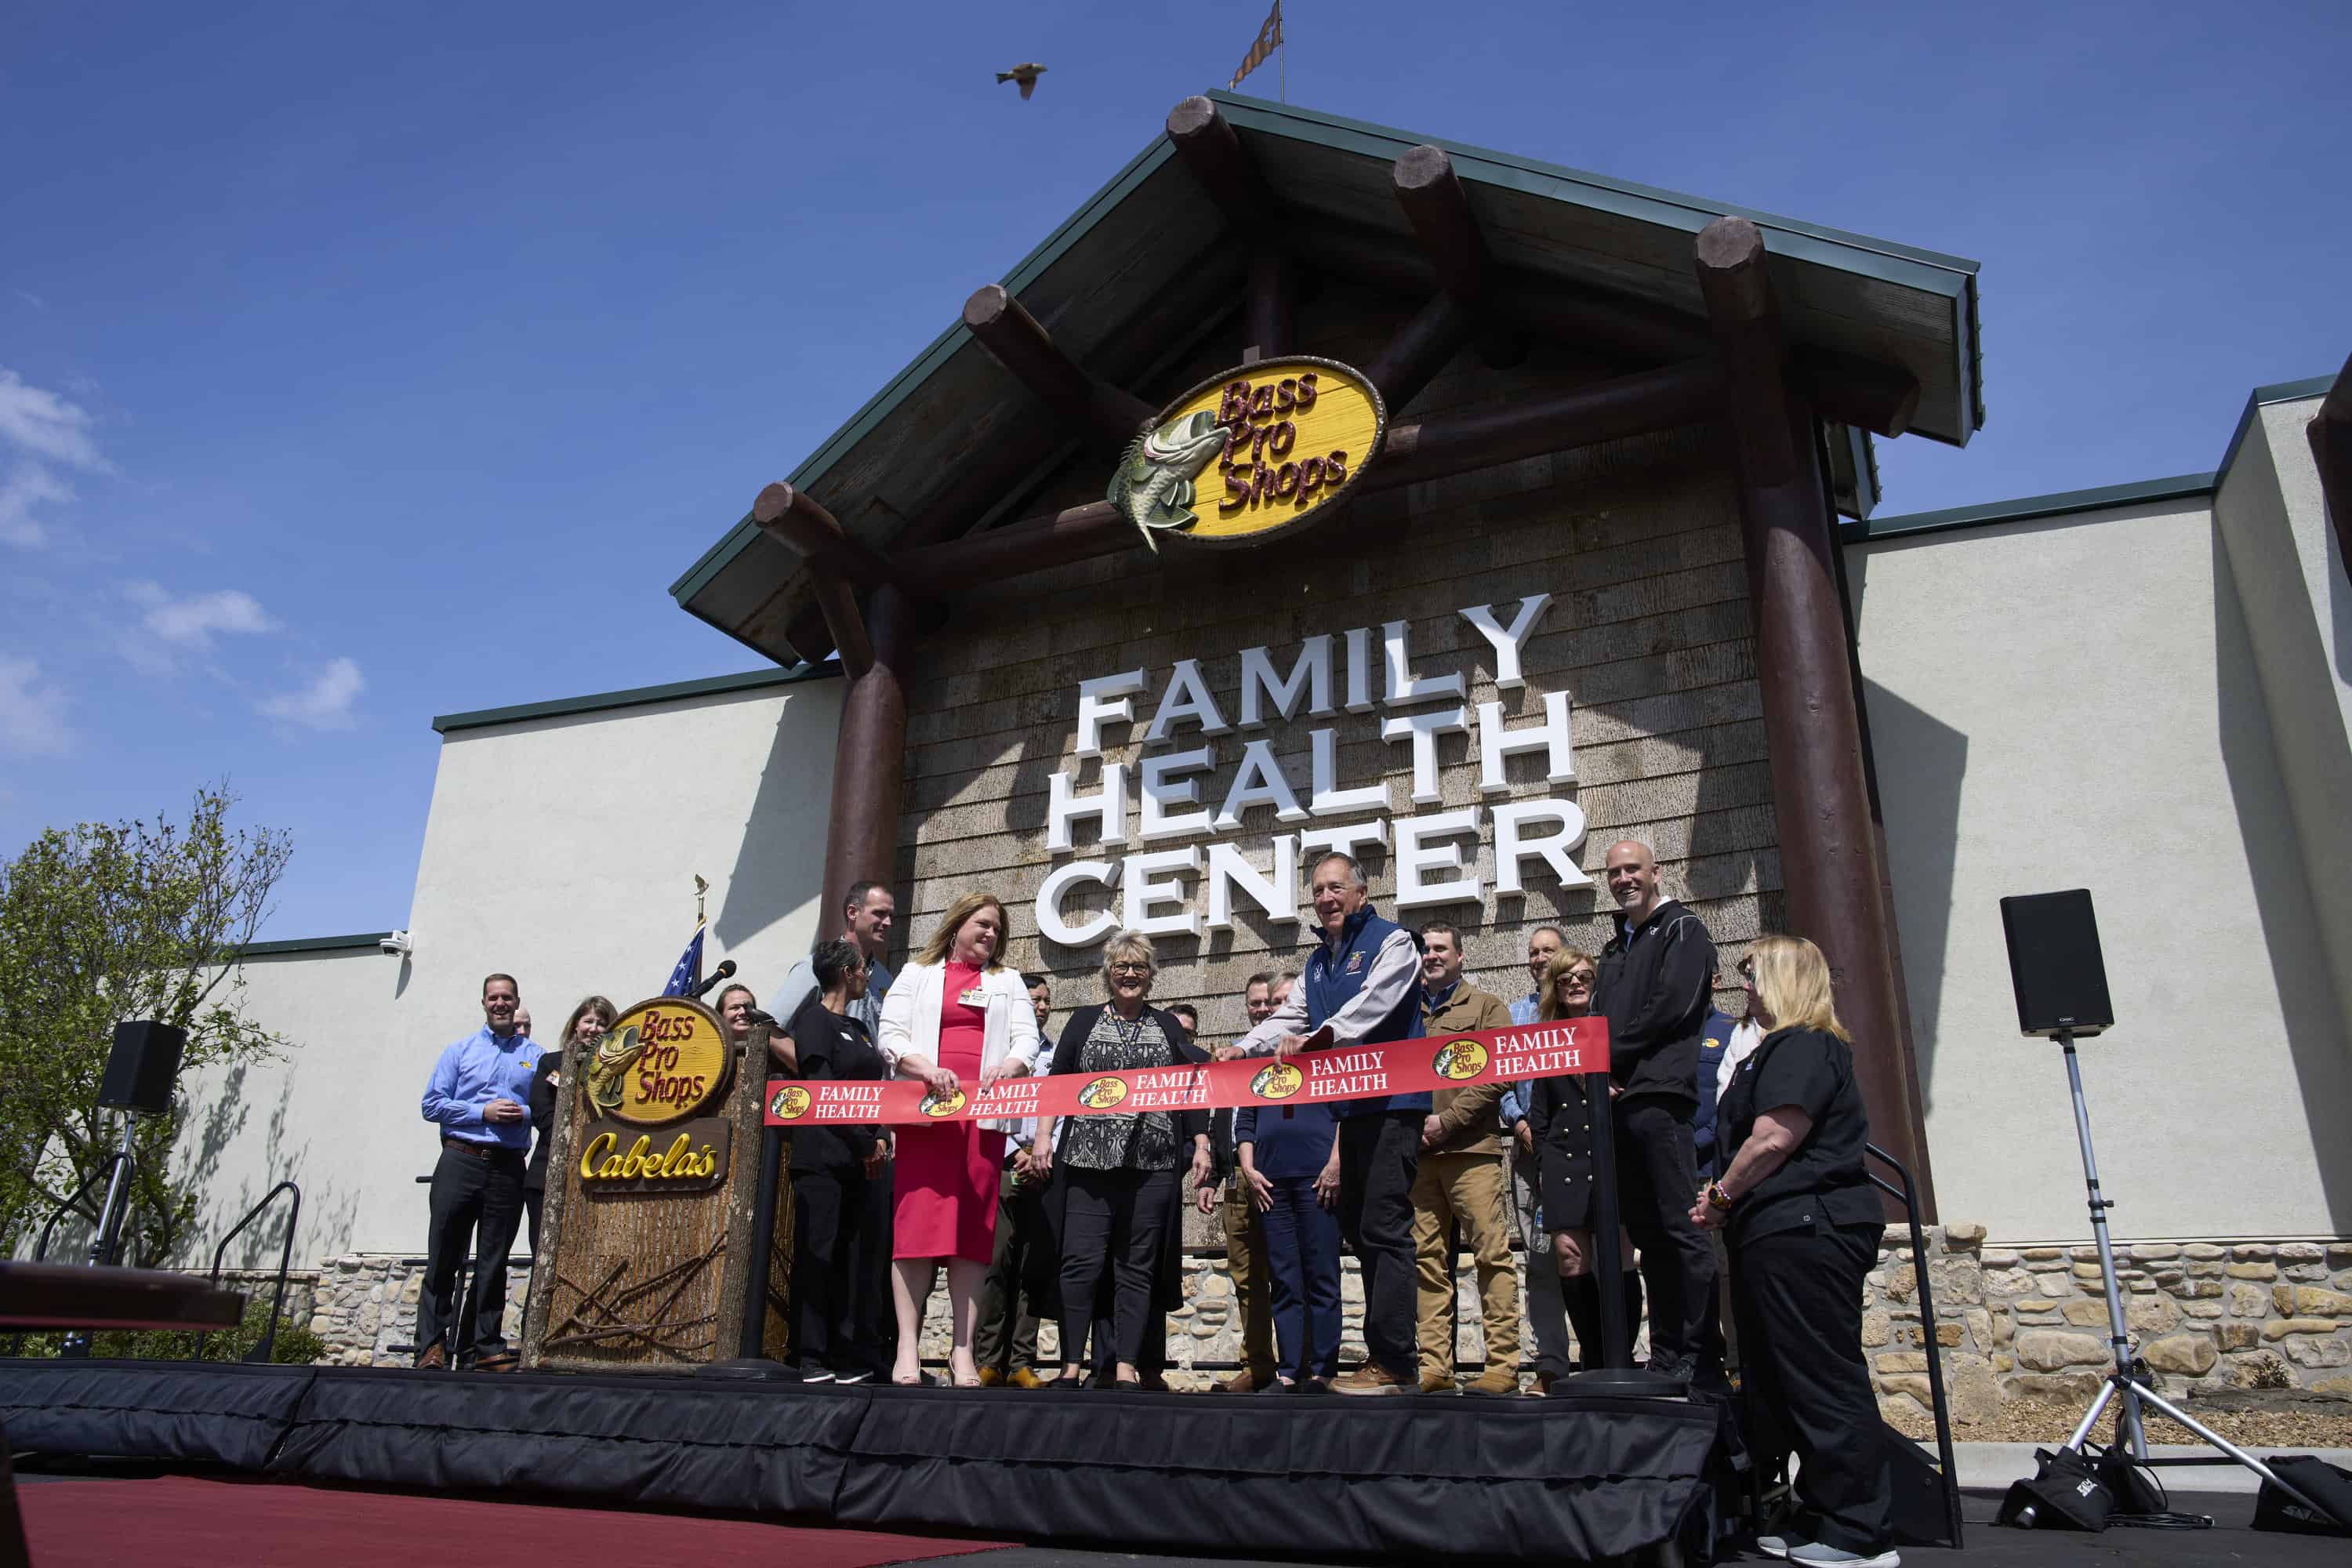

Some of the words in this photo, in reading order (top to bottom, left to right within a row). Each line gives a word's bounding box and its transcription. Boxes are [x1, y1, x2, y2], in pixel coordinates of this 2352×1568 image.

[1216, 372, 1318, 427] Bass
[1218, 420, 1296, 470] Pro
[1218, 450, 1348, 512] Shops
[1074, 593, 1555, 759] FAMILY
[1047, 690, 1577, 855] HEALTH
[1035, 798, 1596, 947] CENTER
[638, 1011, 695, 1043] Bass
[1454, 1043, 1475, 1054] Bass
[1494, 1027, 1577, 1054] FAMILY
[637, 1040, 679, 1073] Pro
[1310, 1051, 1385, 1076] FAMILY
[1454, 1053, 1471, 1064] Pro
[1494, 1050, 1581, 1076] HEALTH
[1454, 1062, 1482, 1073] Shops
[1098, 1080, 1118, 1089] Bass
[1135, 1070, 1209, 1090] FAMILY
[1270, 1083, 1296, 1094] Shops
[1272, 1075, 1287, 1085] Pro
[1310, 1073, 1388, 1097] HEALTH
[635, 1071, 705, 1110] Shops
[786, 1088, 803, 1098] Bass
[818, 1086, 884, 1102] FAMILY
[1096, 1095, 1120, 1105] Shops
[1098, 1088, 1112, 1098] Pro
[1131, 1089, 1207, 1107] HEALTH
[784, 1105, 804, 1115] Shops
[786, 1098, 798, 1107] Pro
[815, 1104, 882, 1119] HEALTH
[967, 1100, 1040, 1116] HEALTH
[580, 1132, 717, 1179] Cabela's
